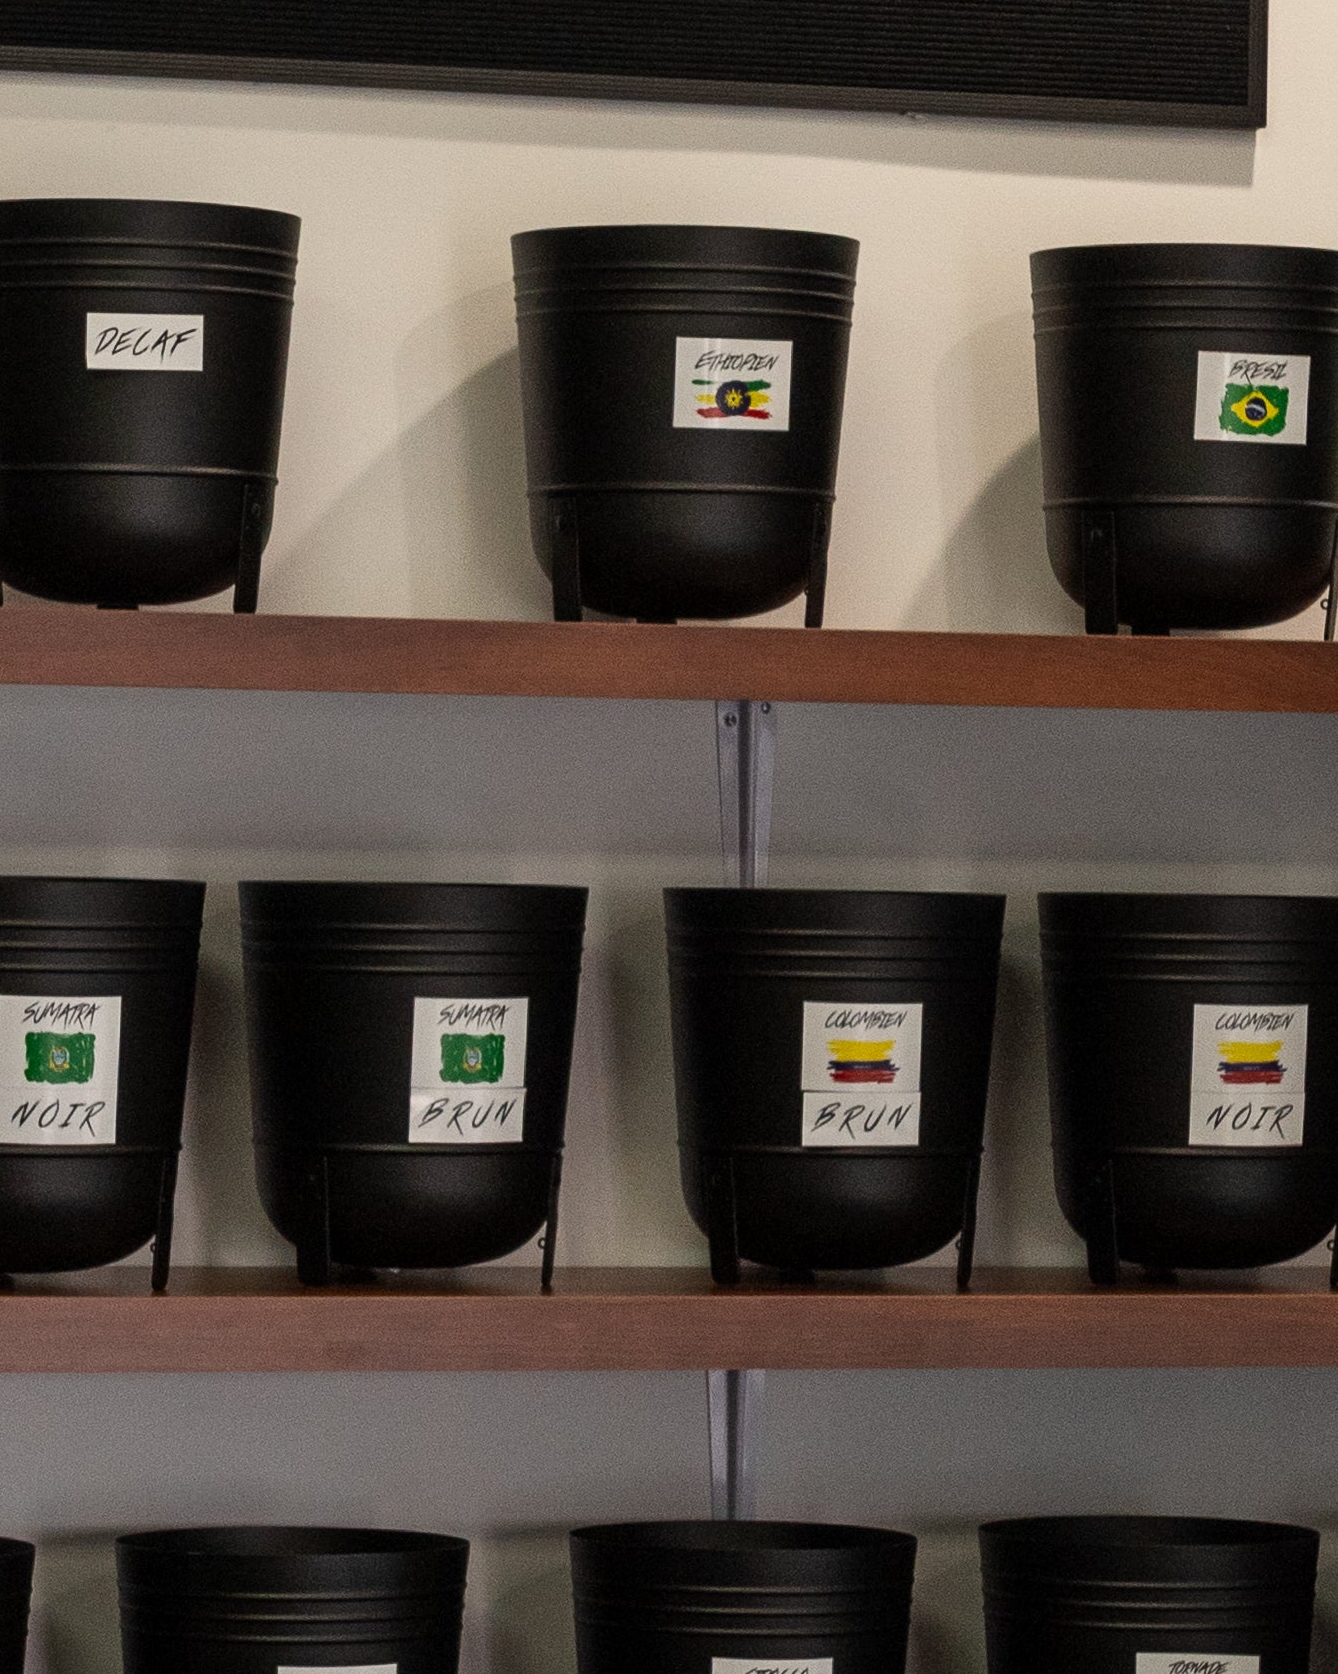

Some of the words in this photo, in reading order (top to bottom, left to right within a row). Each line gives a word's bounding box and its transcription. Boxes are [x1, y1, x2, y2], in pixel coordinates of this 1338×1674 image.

[94, 326, 197, 364] DECAF
[694, 350, 780, 372] ETHIOPIEN
[1228, 359, 1288, 384] BRESIL
[22, 1001, 101, 1030] SUMATRA
[437, 1003, 510, 1031] SUMATRA
[824, 1009, 908, 1031] COLOMBIEN
[1215, 1012, 1294, 1033] COLOMBIEN
[11, 1098, 106, 1137] NOIR
[418, 1098, 517, 1136] BRUN
[811, 1101, 913, 1141] BRUN
[1206, 1102, 1294, 1140] NOIR
